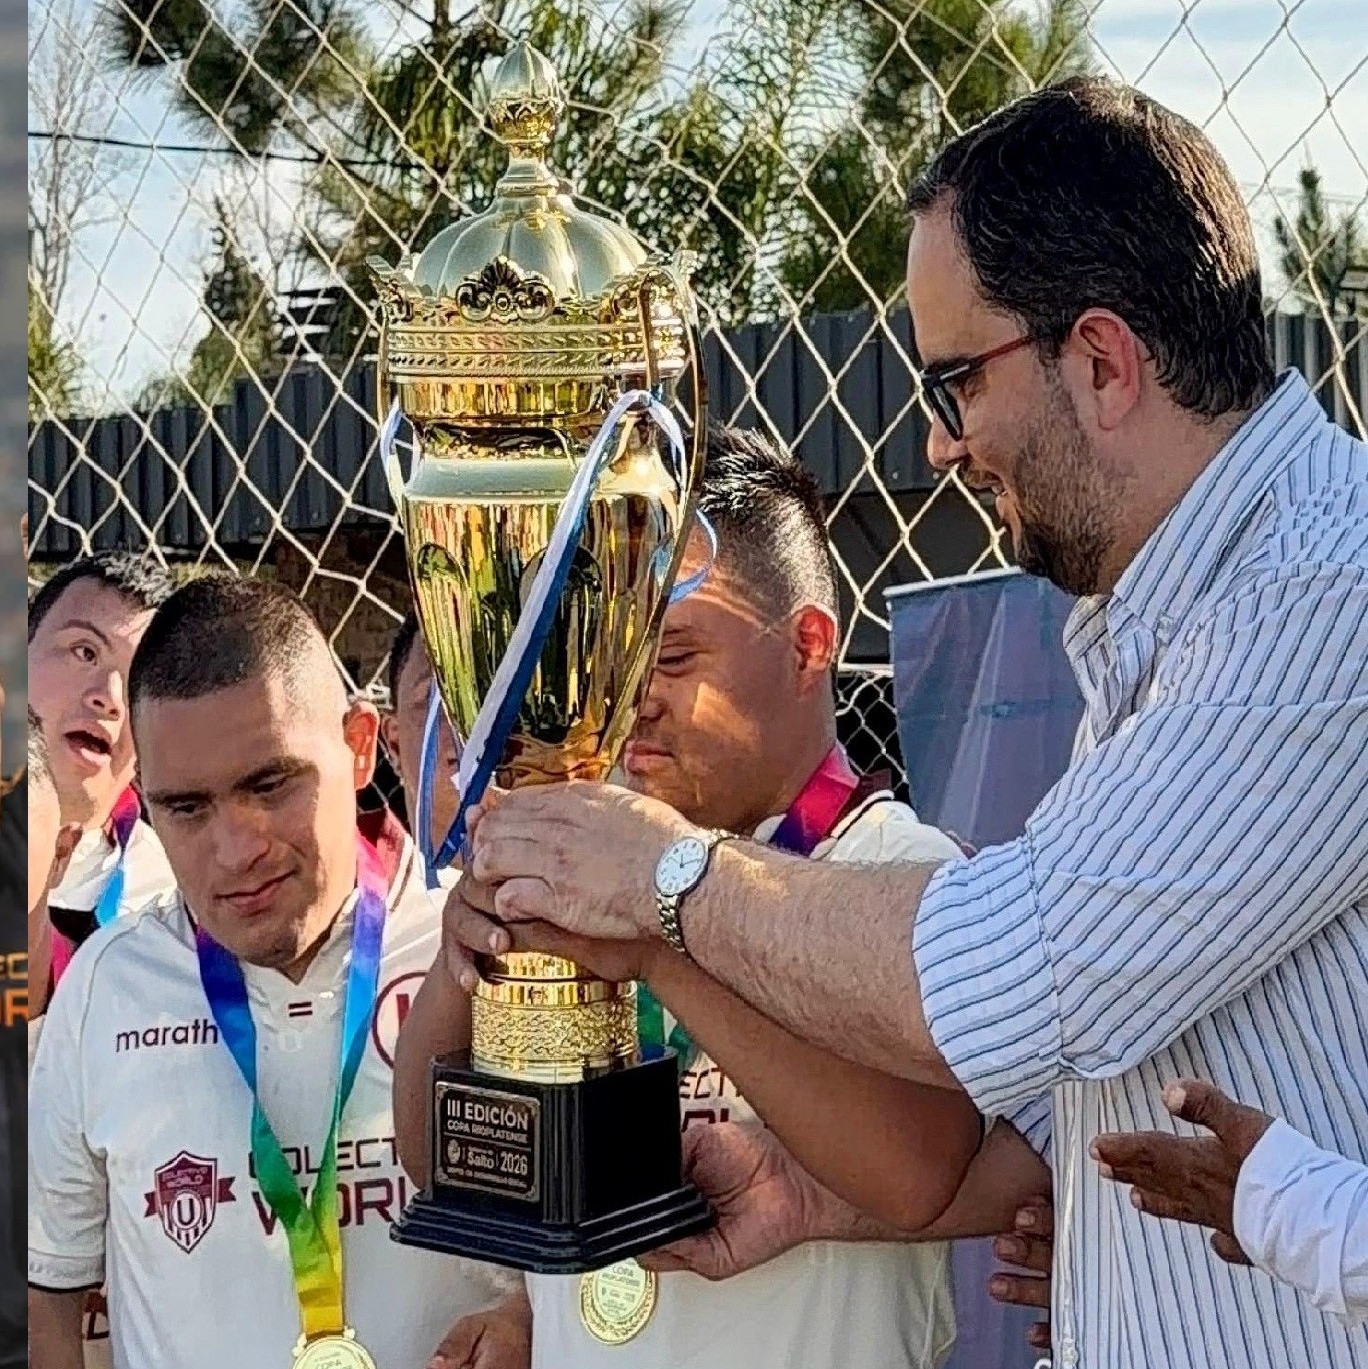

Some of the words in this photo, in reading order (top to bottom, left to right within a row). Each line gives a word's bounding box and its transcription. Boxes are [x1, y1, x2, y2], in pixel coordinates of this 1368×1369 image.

[447, 1098, 461, 1118] III
[464, 1101, 529, 1132] EDICIÓN
[500, 1151, 528, 1176] 2026
[177, 1198, 194, 1226] U
